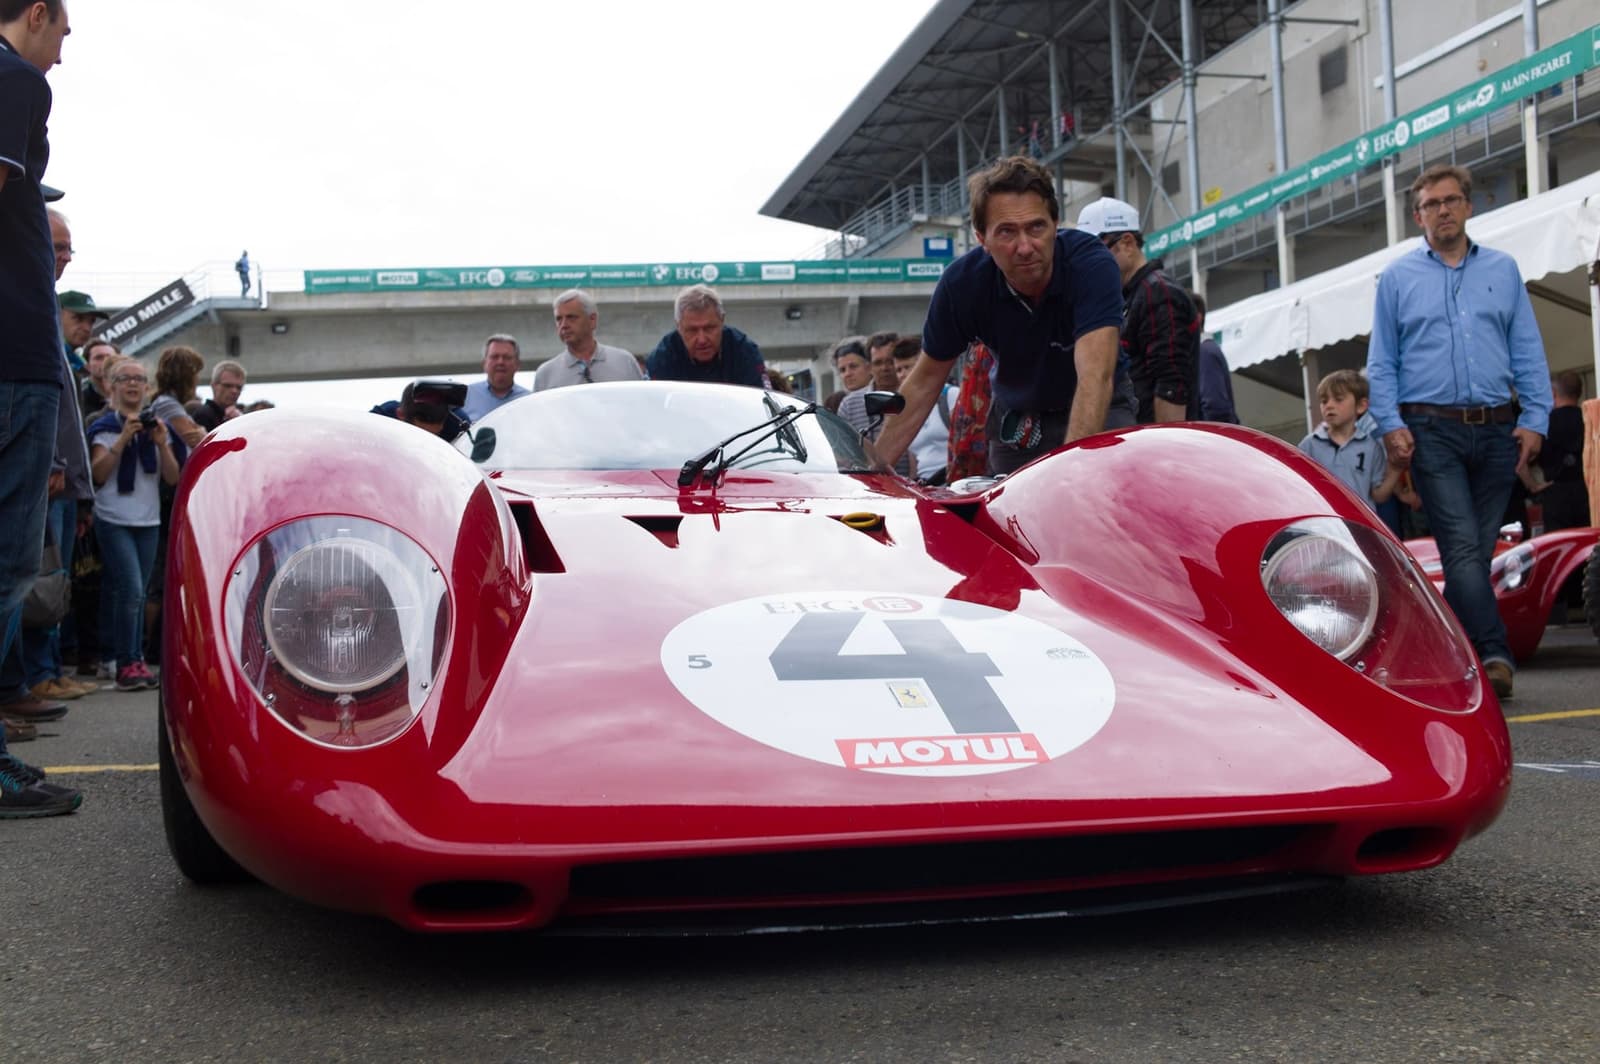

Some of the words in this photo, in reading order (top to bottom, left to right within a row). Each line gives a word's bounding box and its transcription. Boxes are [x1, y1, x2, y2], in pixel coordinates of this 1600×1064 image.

[1500, 71, 1530, 94] ALAIN
[1530, 51, 1573, 79] FIGARET
[1373, 132, 1397, 153] EFG
[380, 274, 415, 283] MOTUL
[459, 271, 488, 284] EFG
[675, 267, 702, 280] EFG
[99, 315, 138, 343] ARD
[137, 288, 184, 321] MILLE
[1355, 451, 1366, 472] 1
[761, 599, 860, 614] EFG
[687, 654, 713, 670] 5
[768, 611, 1022, 735] 4
[854, 737, 1040, 765] MOTUL
